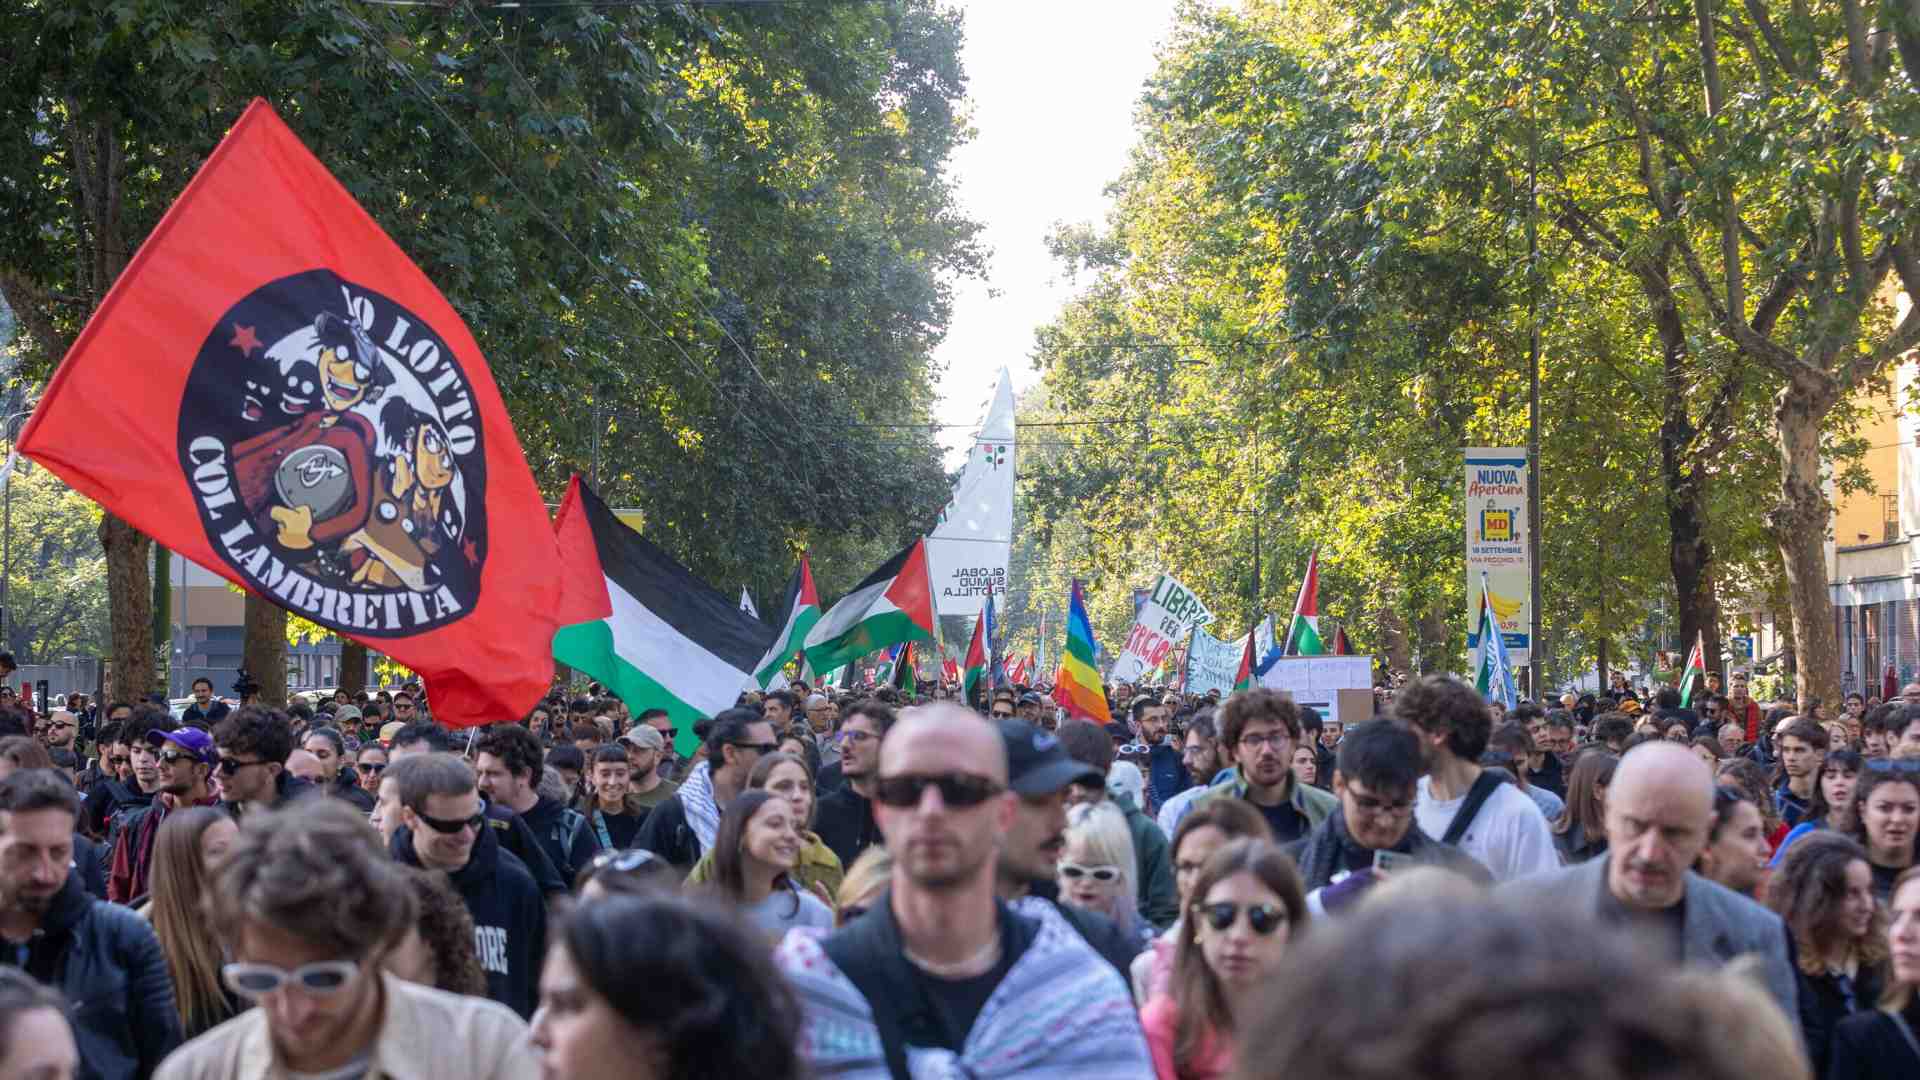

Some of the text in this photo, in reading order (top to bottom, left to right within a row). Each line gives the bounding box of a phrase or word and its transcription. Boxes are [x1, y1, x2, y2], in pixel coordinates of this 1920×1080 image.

[384, 316, 475, 455] LOTTO
[1477, 470, 1518, 484] NUOVA
[1468, 481, 1524, 498] Apertura
[1486, 518, 1508, 530] MD
[189, 436, 462, 630] COL LAMBRETTA
